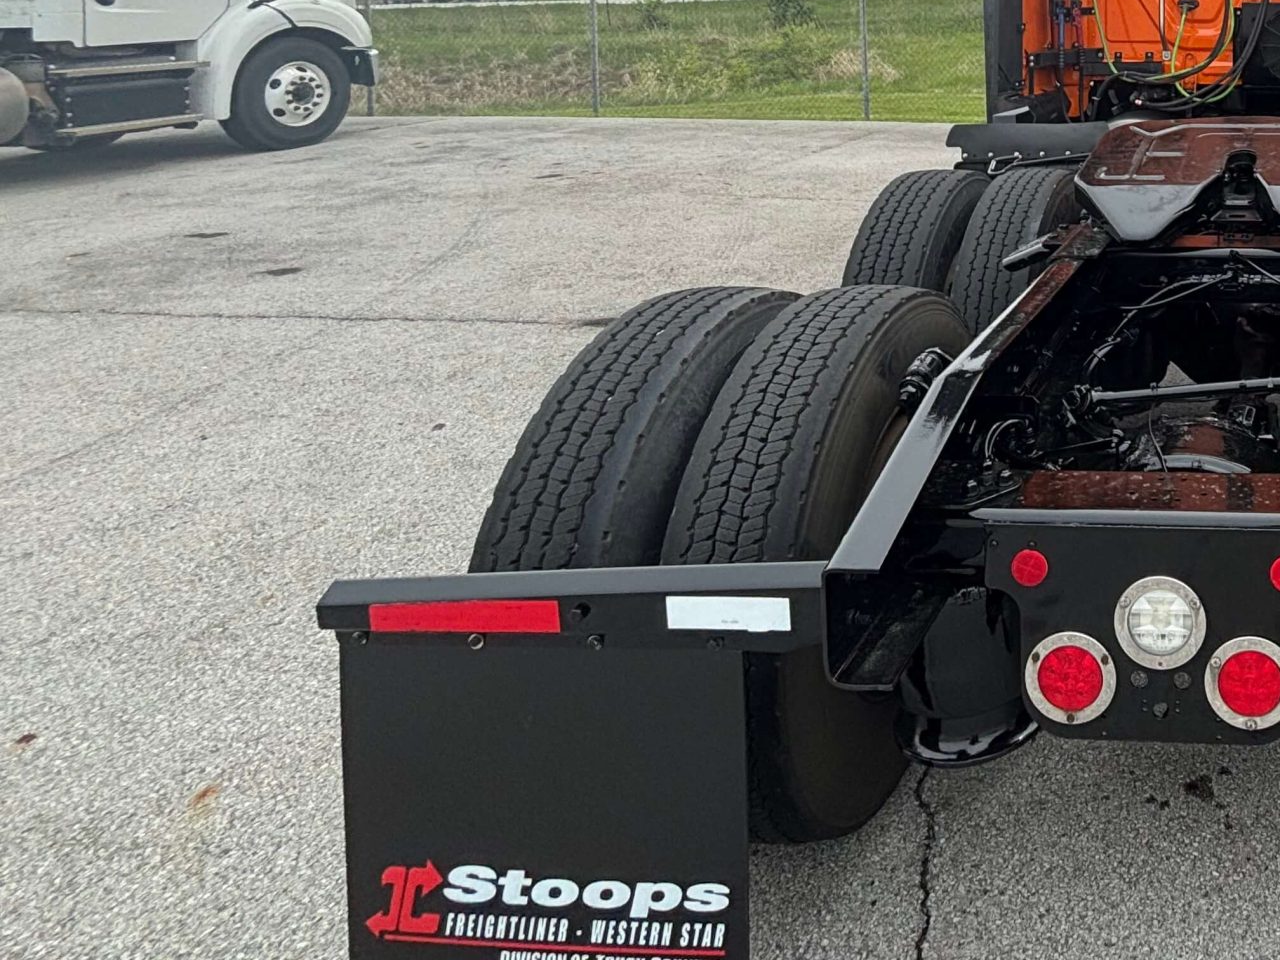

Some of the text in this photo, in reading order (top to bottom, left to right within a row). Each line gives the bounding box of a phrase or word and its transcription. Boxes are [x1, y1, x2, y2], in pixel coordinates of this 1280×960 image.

[443, 864, 730, 919] Stoops
[445, 912, 725, 948] FREIGHTLINER WESTERN STAR
